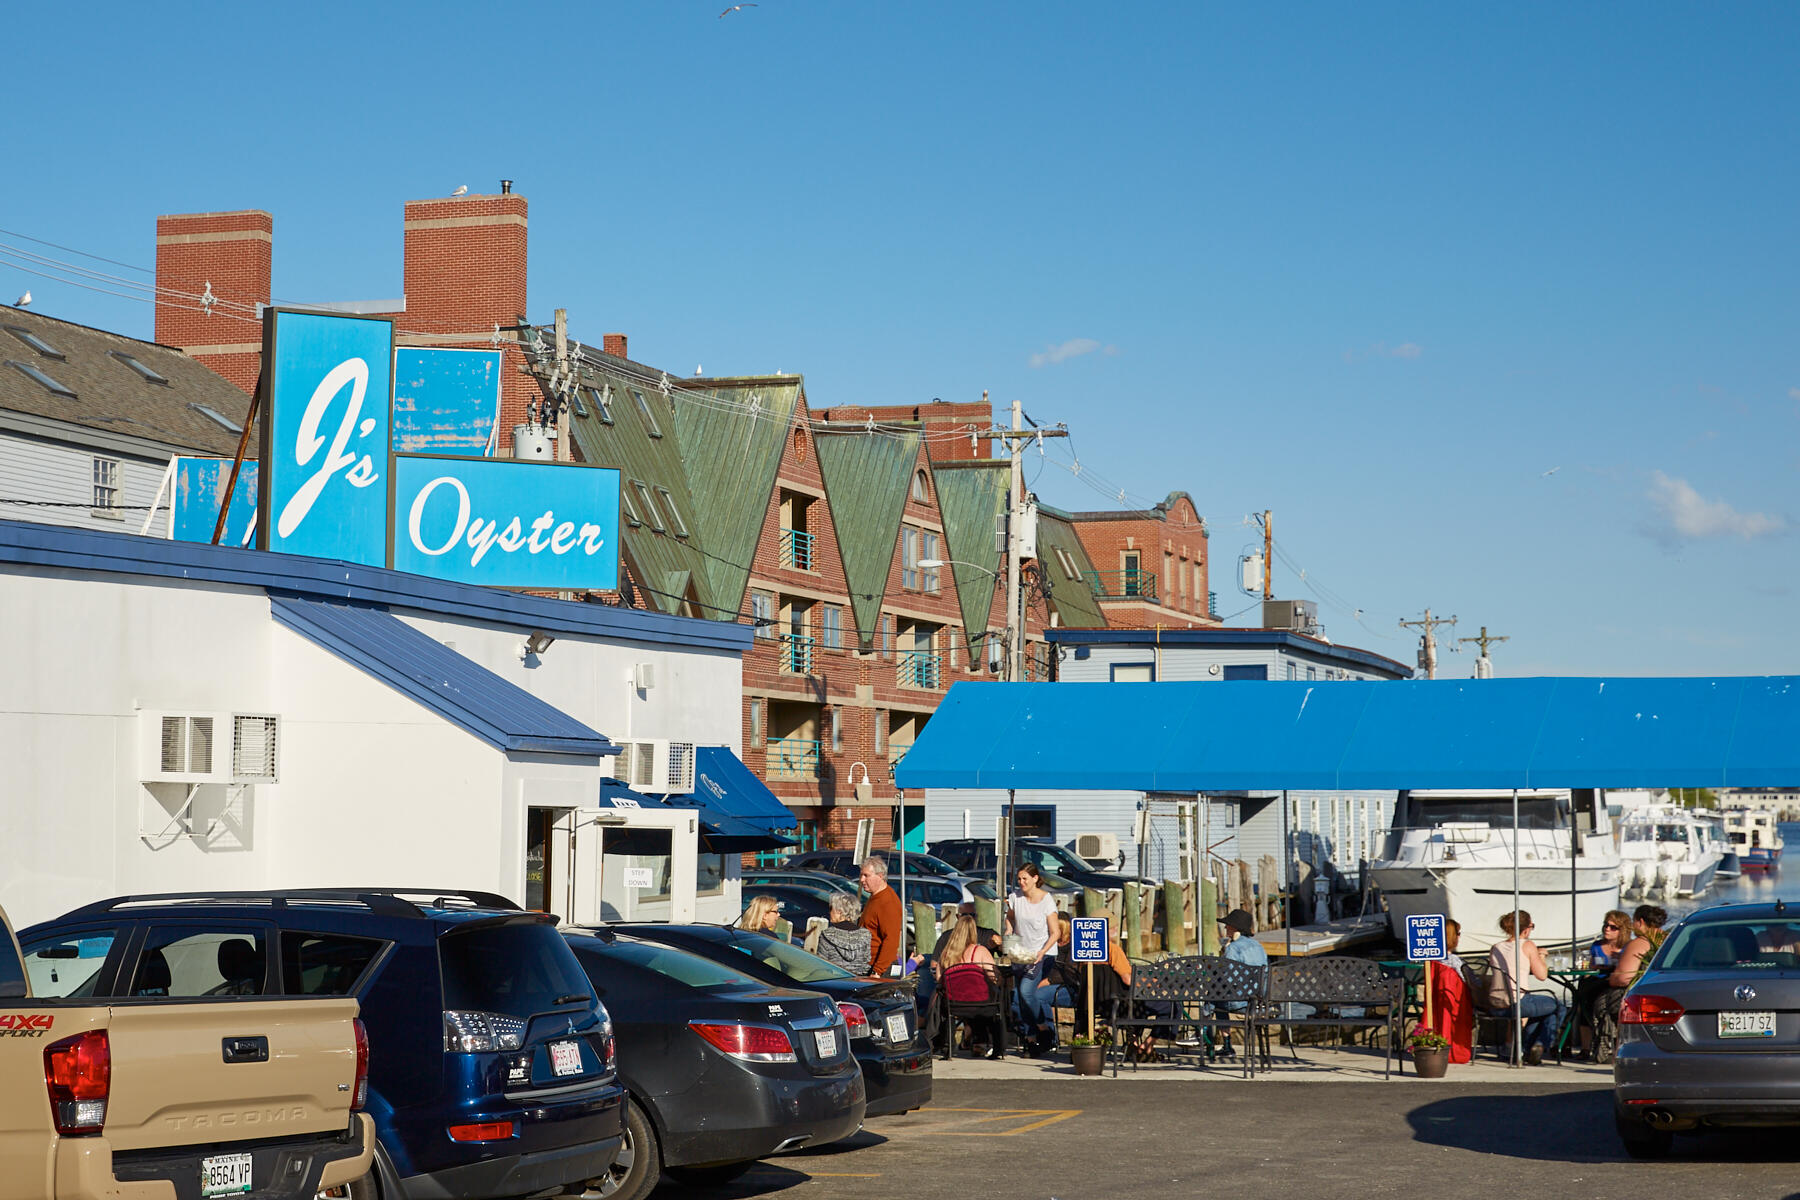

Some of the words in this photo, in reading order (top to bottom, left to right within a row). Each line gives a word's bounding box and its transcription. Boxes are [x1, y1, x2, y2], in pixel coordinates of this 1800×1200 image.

[278, 357, 378, 538] J's
[409, 476, 604, 567] Oyster
[1411, 919, 1439, 927] PLEASE
[1081, 931, 1098, 939] WAIT
[1416, 939, 1426, 947] TO
[1427, 938, 1437, 946] BE
[1077, 950, 1102, 958] SEATED
[1413, 948, 1440, 957] SEATED
[1728, 1016, 1755, 1030] 6217
[1758, 1016, 1772, 1030] SZ
[165, 1107, 308, 1130] TACOMA
[215, 1156, 238, 1164] MAINE
[210, 1164, 235, 1186] 8564
[239, 1163, 250, 1183] VP
